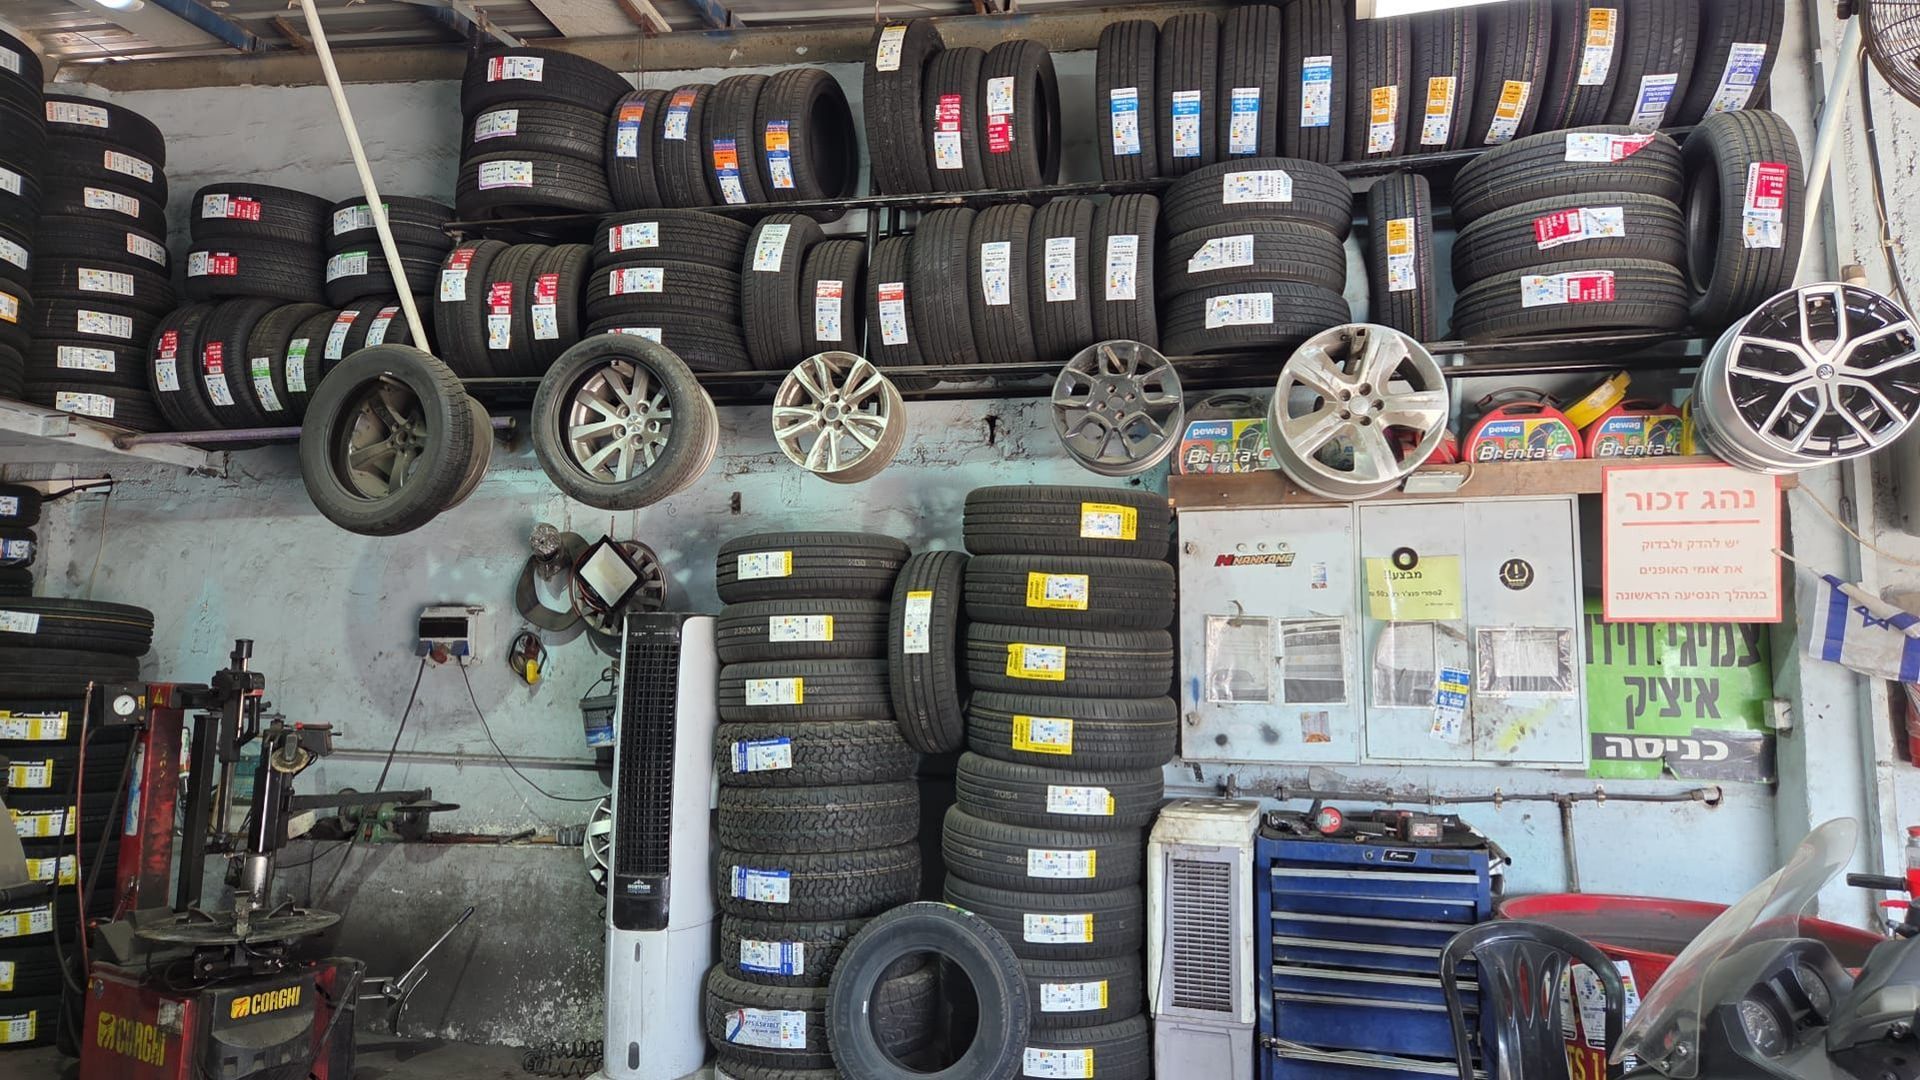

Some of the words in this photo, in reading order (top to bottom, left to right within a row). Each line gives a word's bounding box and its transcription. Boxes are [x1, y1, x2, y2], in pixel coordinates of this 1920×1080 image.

[1193, 426, 1228, 436] pewag
[1488, 424, 1521, 434] pewag
[1608, 422, 1641, 431] pewag
[1625, 490, 1689, 511] זכור
[1700, 489, 1756, 510] נהג
[1641, 538, 1683, 551] ולבדוק
[1687, 538, 1721, 551] להדק
[1725, 539, 1739, 548] יש
[1233, 553, 1295, 566] NANKANG
[1639, 565, 1688, 575] האופנים
[1692, 565, 1719, 574] אומי
[1724, 565, 1743, 574] את
[1616, 590, 1669, 600] הראשונה
[1675, 590, 1719, 600] הנסיעה
[1725, 589, 1767, 602] במהלך
[1623, 677, 1721, 729] איציק
[1604, 736, 1729, 761] כניסה
[251, 986, 301, 1015] CORGHI
[115, 1017, 166, 1067] CORGHI
